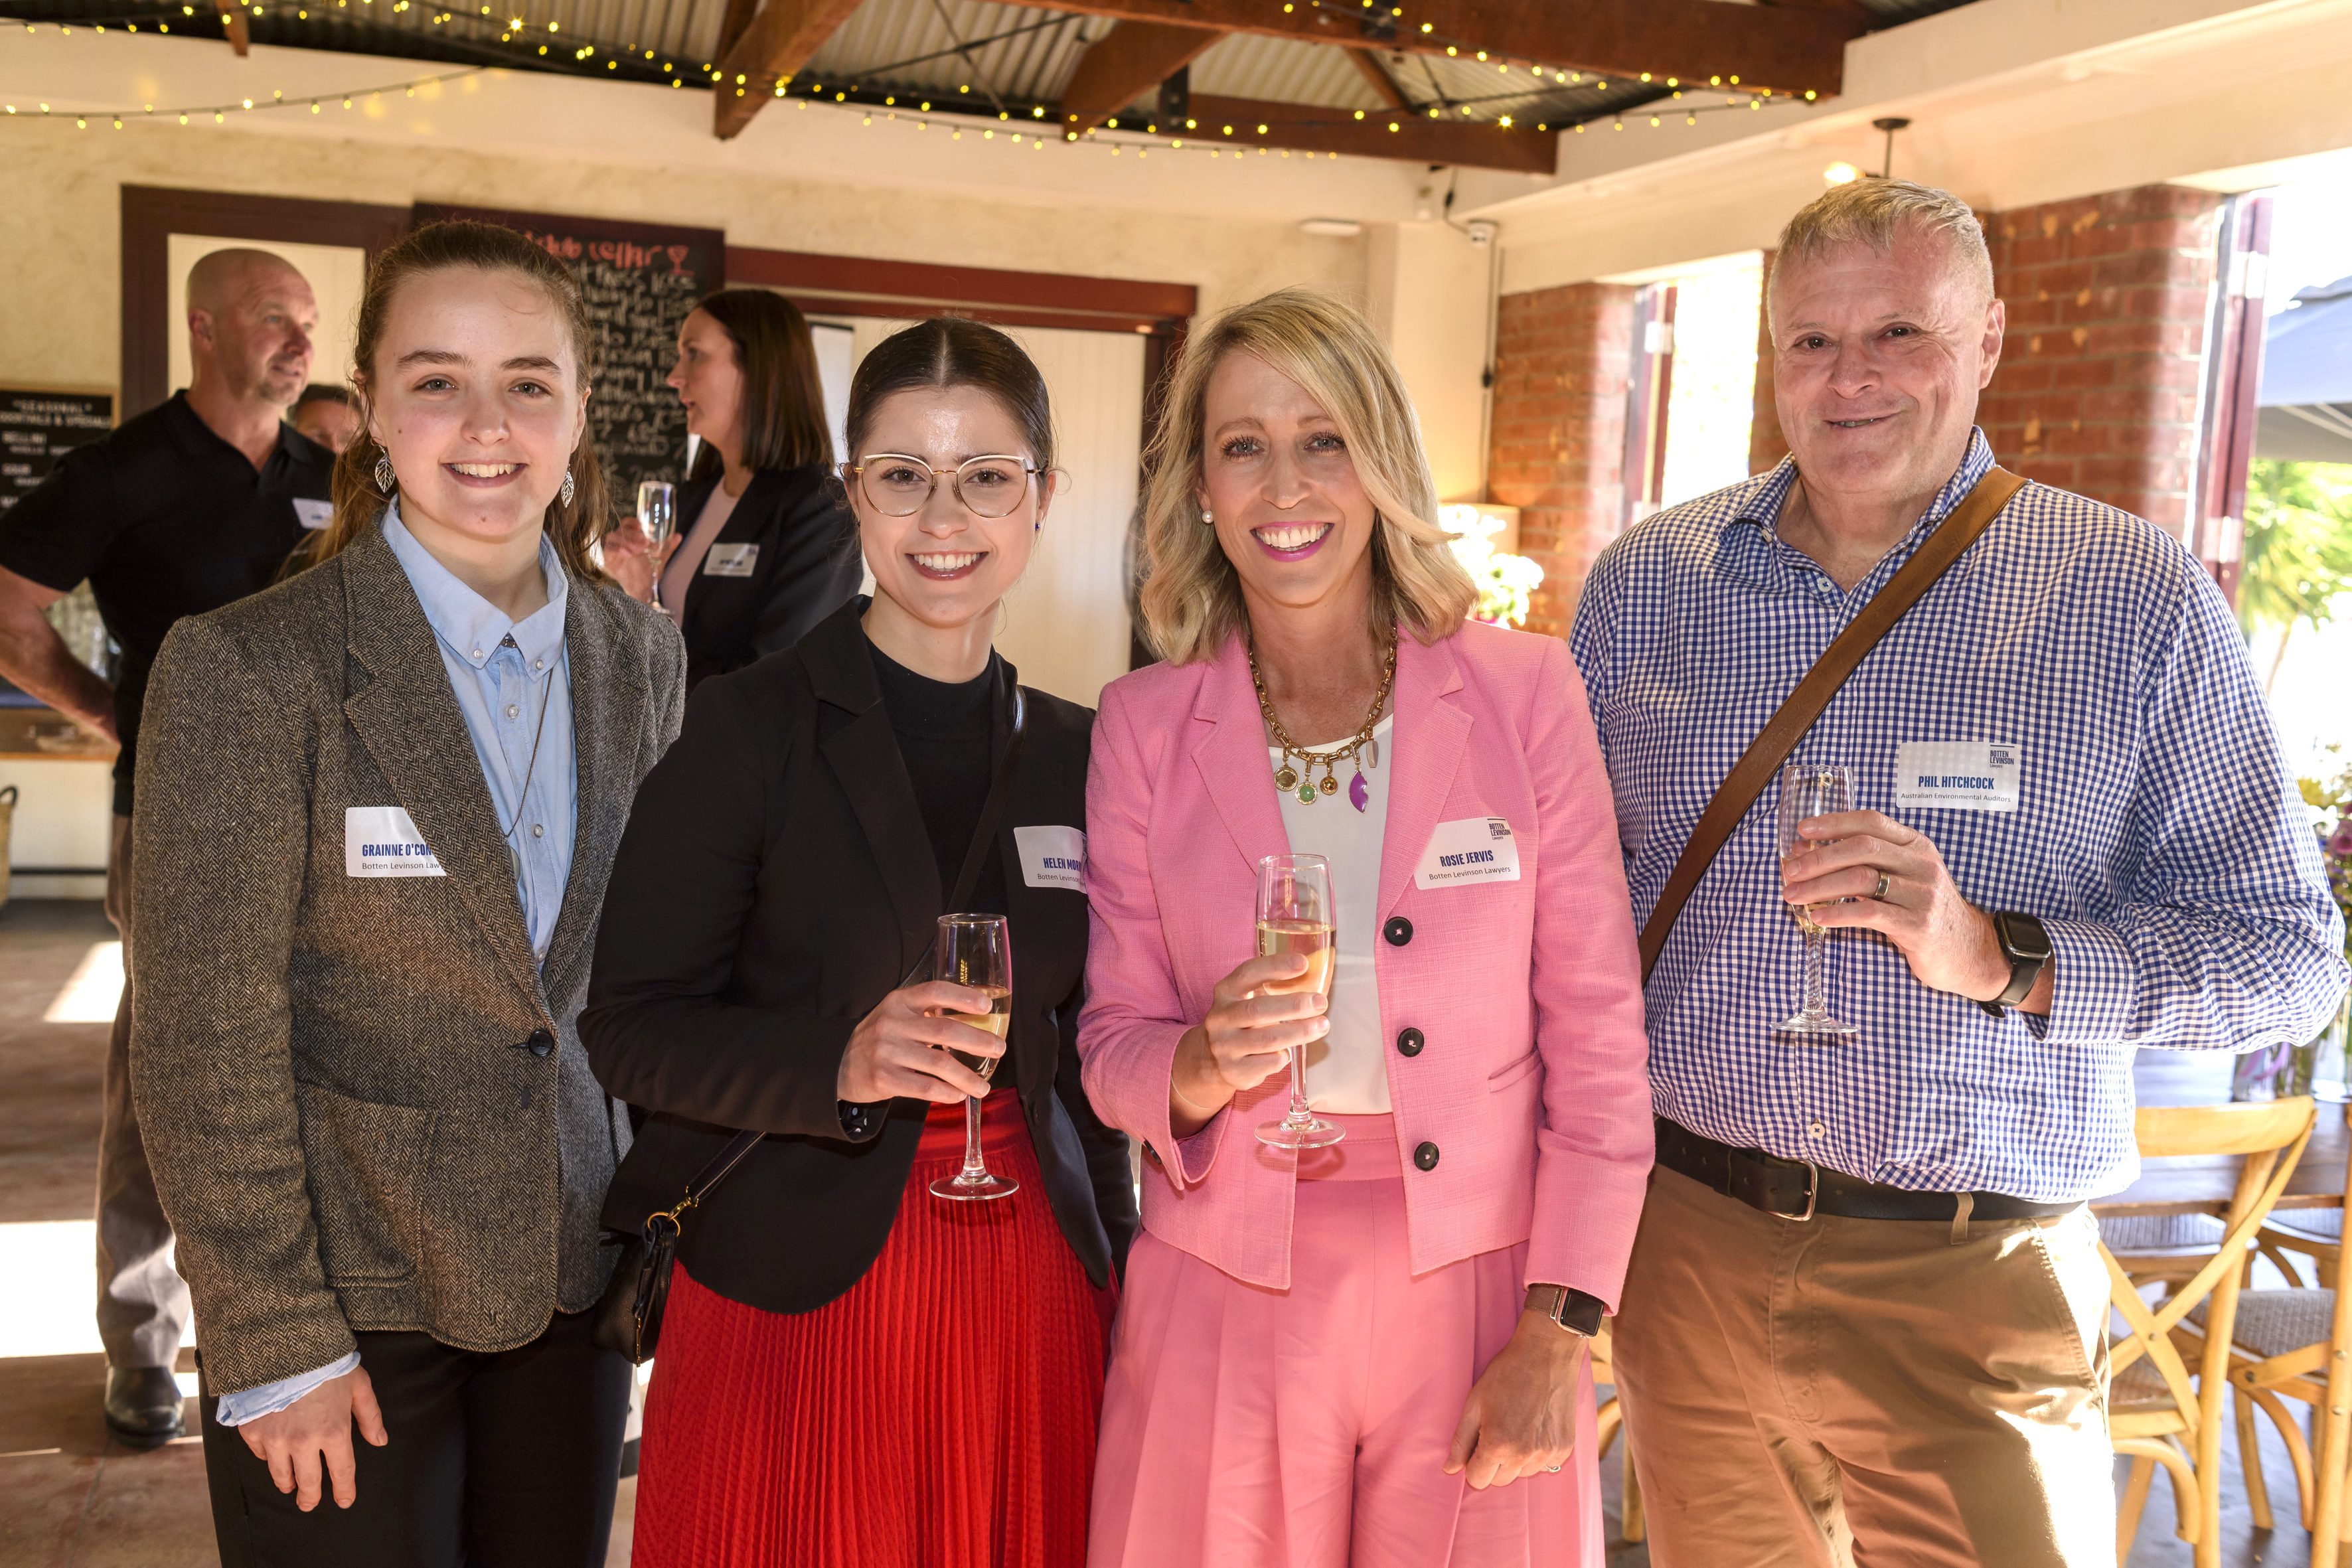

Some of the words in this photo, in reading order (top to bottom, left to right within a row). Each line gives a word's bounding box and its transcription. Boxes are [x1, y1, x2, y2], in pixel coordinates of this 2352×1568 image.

[1919, 776, 1939, 787] PHIL
[1942, 776, 1994, 789] HITCHCOCK
[362, 844, 403, 856] GRAINNE
[1043, 858, 1066, 869] HELEN
[1440, 853, 1465, 867] ROSIE
[1466, 850, 1494, 864] JERVIS
